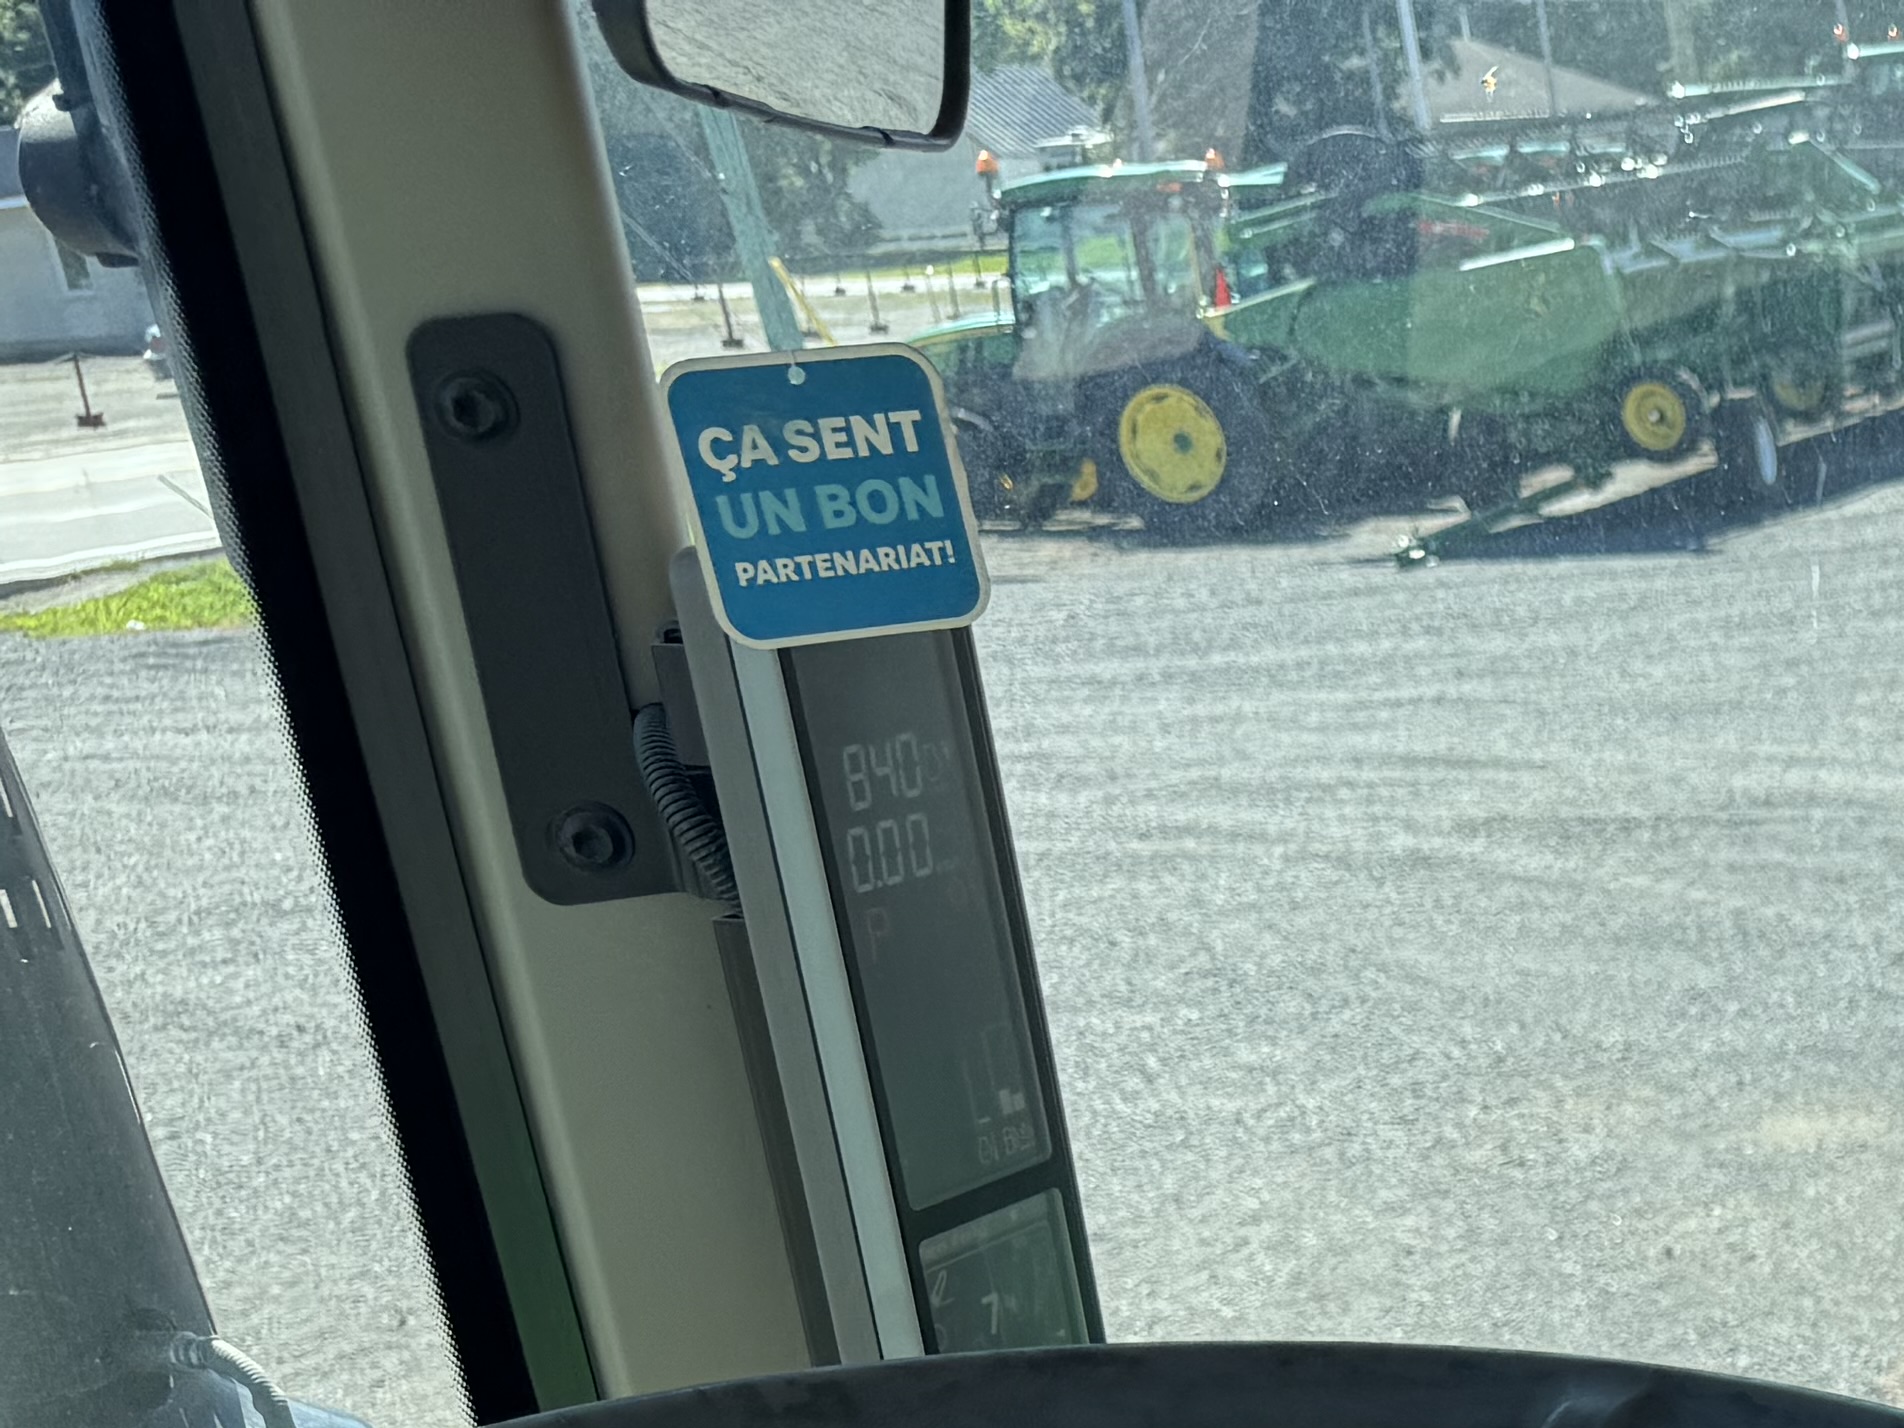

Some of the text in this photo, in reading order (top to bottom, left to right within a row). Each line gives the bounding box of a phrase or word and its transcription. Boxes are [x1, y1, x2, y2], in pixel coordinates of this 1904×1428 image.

[698, 410, 921, 483] ÇA SENT
[716, 474, 945, 539] UN BON
[734, 540, 956, 588] PARTENARIAT!
[842, 732, 923, 811] 840
